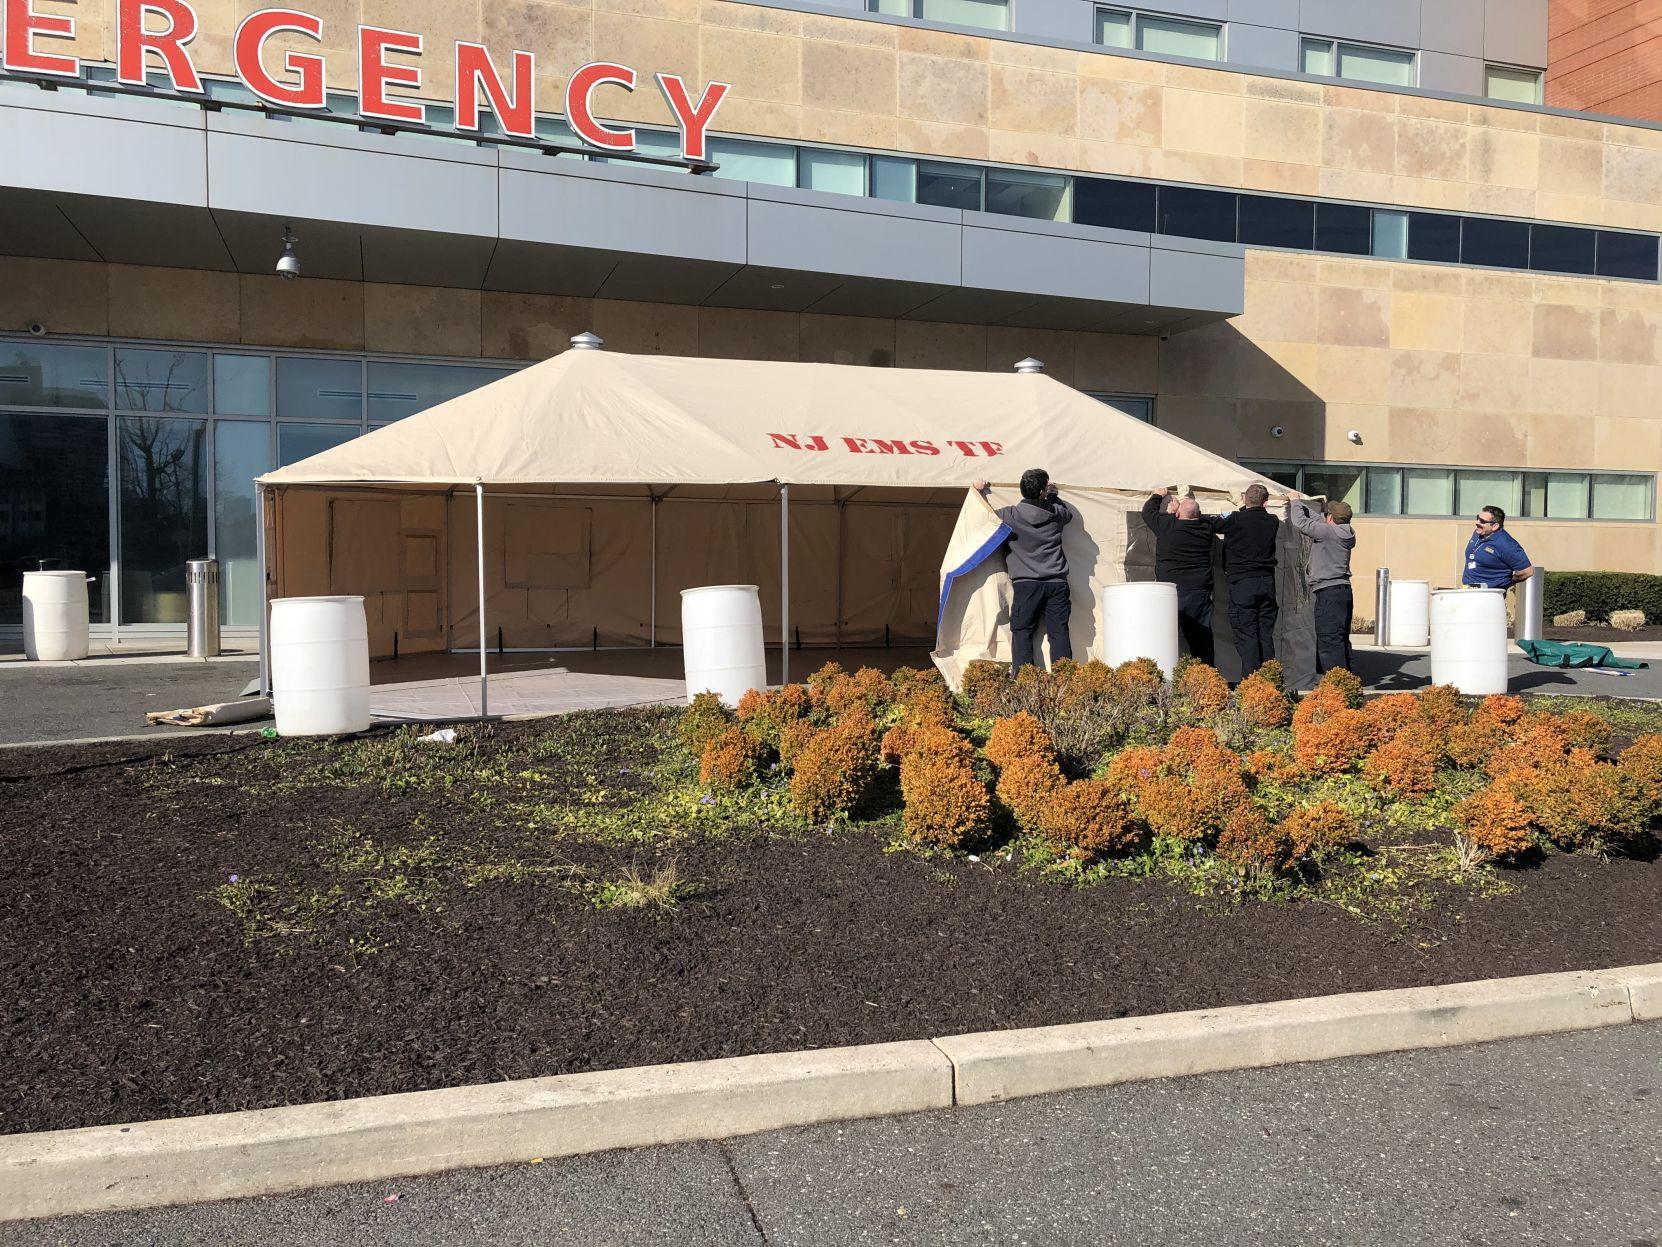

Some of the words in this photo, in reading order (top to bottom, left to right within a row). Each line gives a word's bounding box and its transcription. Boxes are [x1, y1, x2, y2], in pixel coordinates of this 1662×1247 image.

[3, 0, 732, 161] ERGENCY
[766, 432, 831, 452] NJ
[840, 437, 941, 456] EMS
[946, 440, 1004, 457] TF
